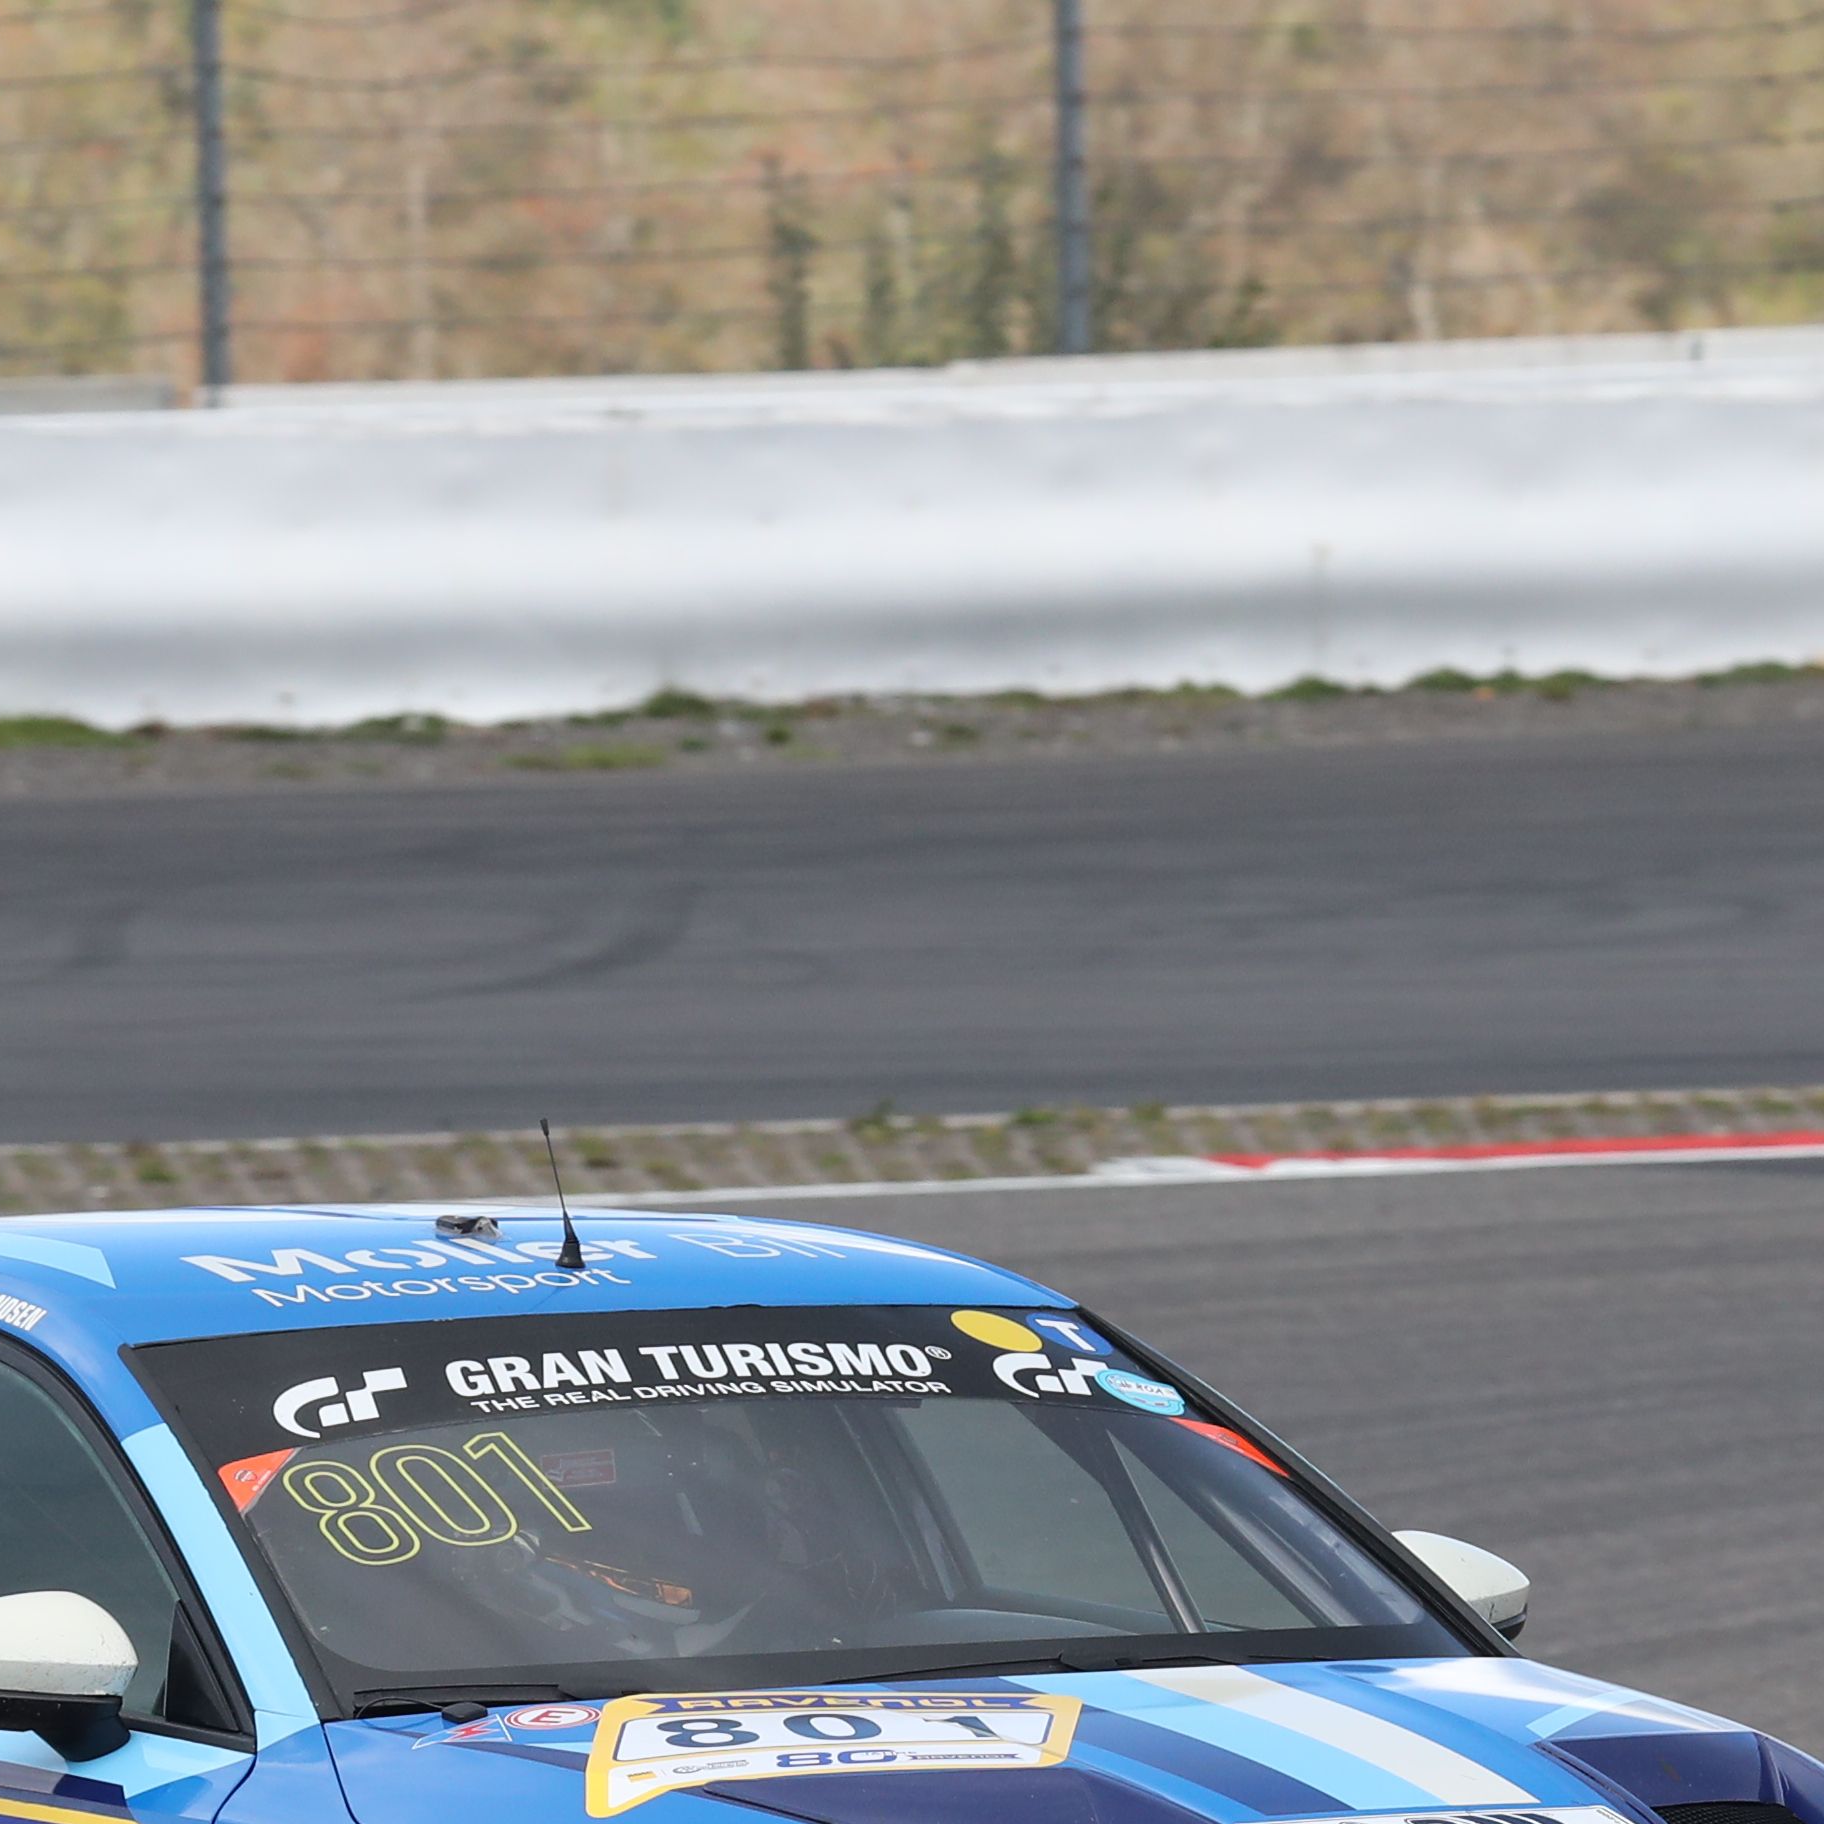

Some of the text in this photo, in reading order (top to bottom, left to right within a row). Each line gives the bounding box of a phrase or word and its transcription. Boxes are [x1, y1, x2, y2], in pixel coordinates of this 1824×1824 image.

[668, 1231, 846, 1260] Bil
[251, 1264, 631, 1308] Motorsport
[445, 1348, 633, 1398] GRAN
[470, 1380, 952, 1414] THE REAL DRIVING SIMULATOR
[282, 1431, 592, 1566] 801
